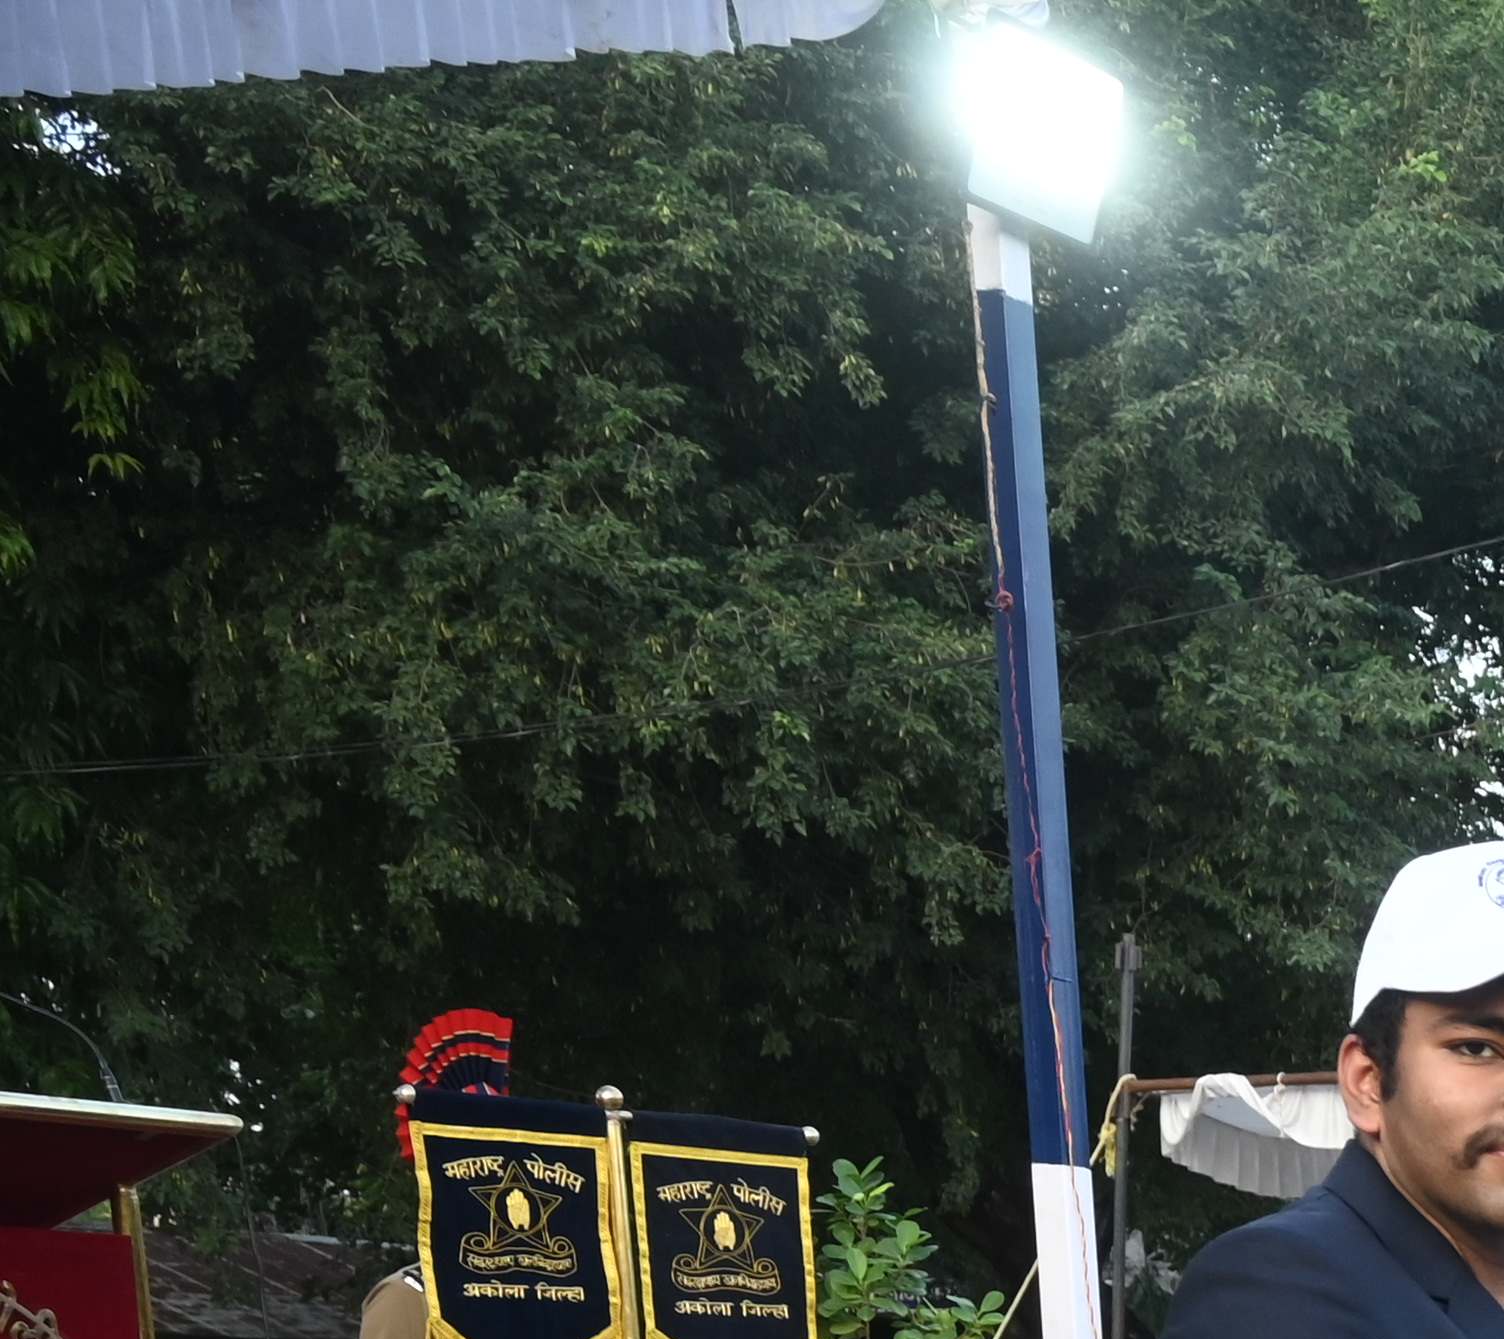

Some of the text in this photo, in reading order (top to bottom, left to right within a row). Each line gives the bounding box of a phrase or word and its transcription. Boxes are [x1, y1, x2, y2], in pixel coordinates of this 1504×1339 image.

[523, 1153, 586, 1193] पोलीस
[730, 1177, 787, 1216] पोलीस
[463, 1279, 584, 1302] अकोला जिल्हा
[675, 1297, 789, 1319] अकोला जिल्हा
